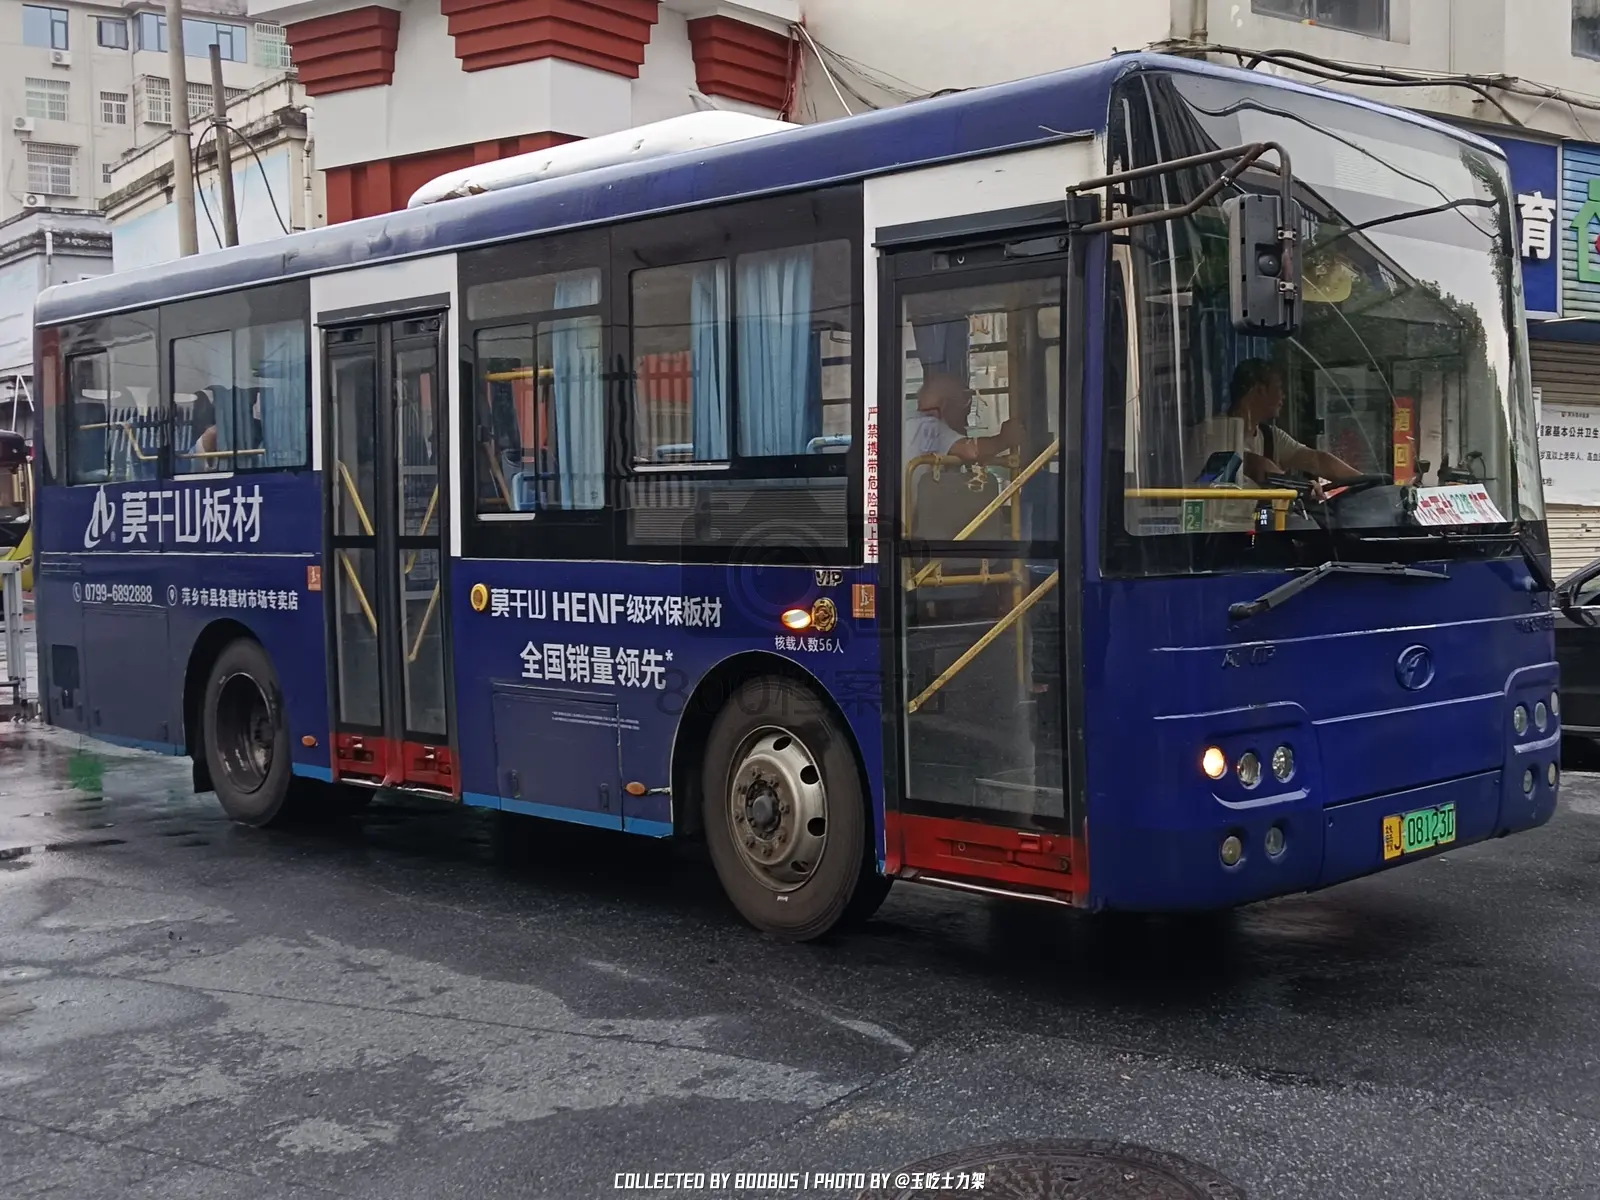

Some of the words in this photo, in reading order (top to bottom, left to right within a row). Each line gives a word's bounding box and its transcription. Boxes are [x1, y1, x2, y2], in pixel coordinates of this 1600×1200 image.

[1517, 191, 1555, 259] 育
[867, 406, 878, 558] 严禁携带危险品上车
[121, 484, 263, 543] 莫干山板材
[815, 569, 843, 586] VIP
[85, 583, 153, 603] 0799-6892888
[181, 587, 299, 610] 萍乡市县各建材市场专卖店
[775, 635, 844, 654] 核载人数56人
